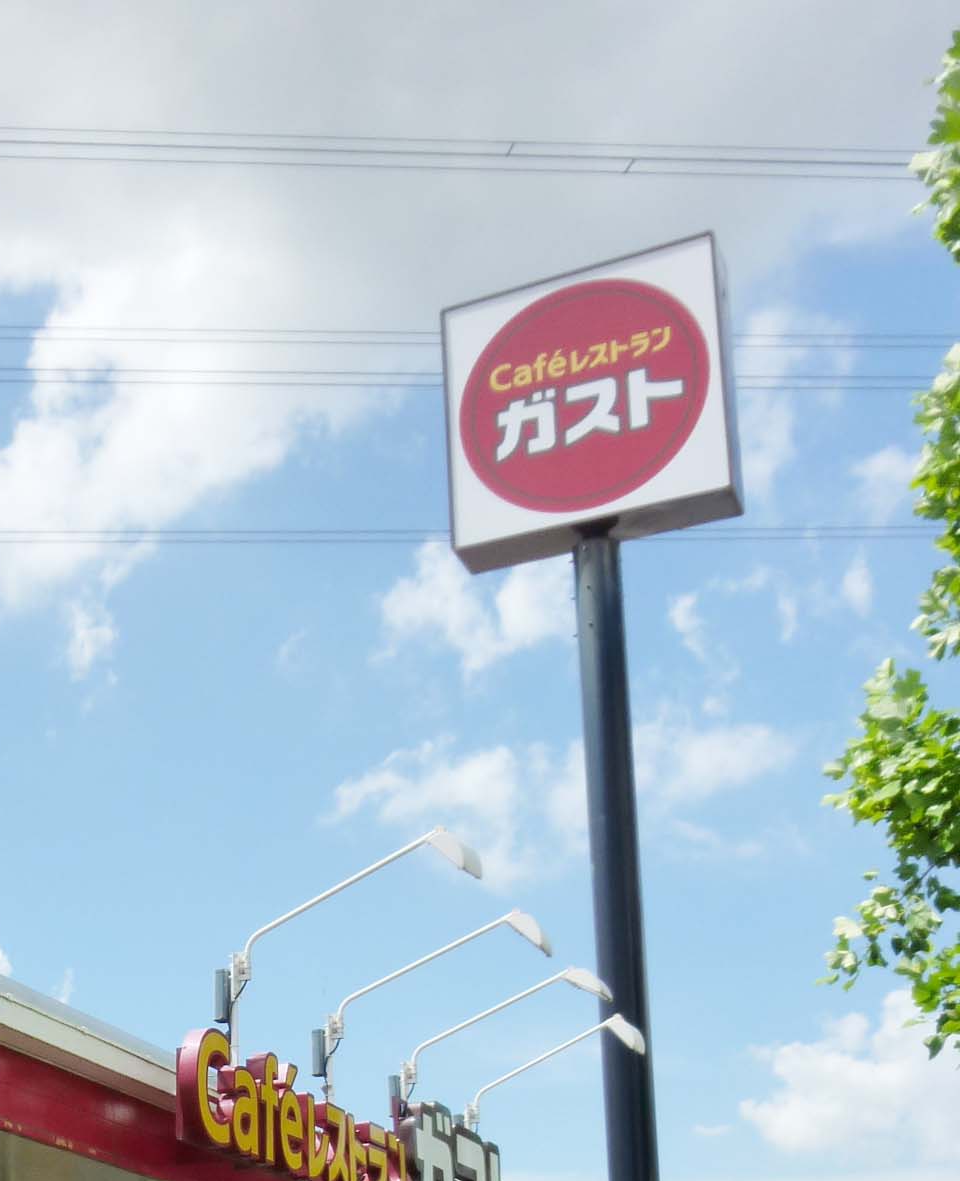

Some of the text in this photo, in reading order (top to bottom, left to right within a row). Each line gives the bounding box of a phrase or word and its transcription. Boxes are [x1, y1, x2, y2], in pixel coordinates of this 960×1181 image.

[489, 326, 671, 392] Caféレストラン
[496, 368, 684, 462] ガスト
